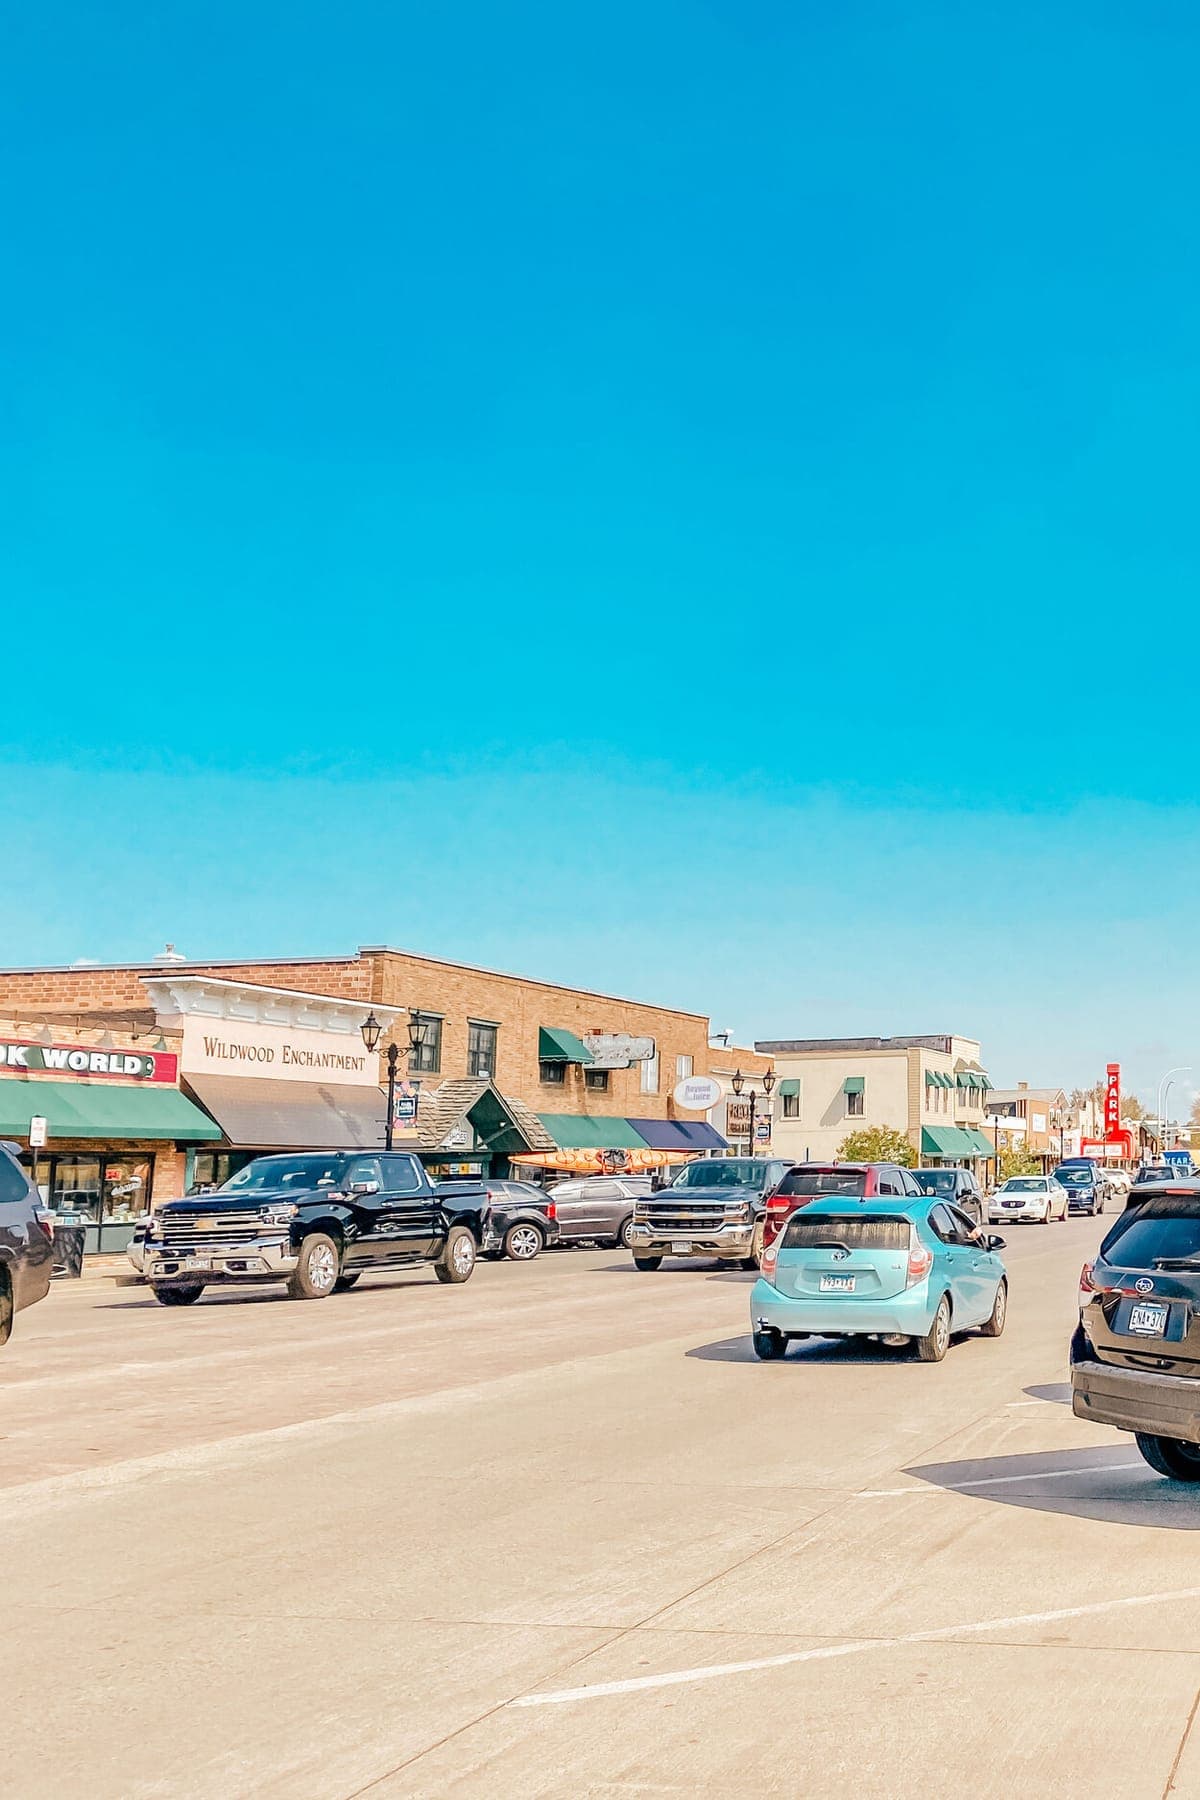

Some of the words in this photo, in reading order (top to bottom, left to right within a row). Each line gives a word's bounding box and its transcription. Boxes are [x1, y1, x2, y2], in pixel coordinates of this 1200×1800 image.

[0, 1044, 28, 1067] K
[41, 1047, 142, 1075] WORLD
[1109, 1076, 1118, 1121] PARK
